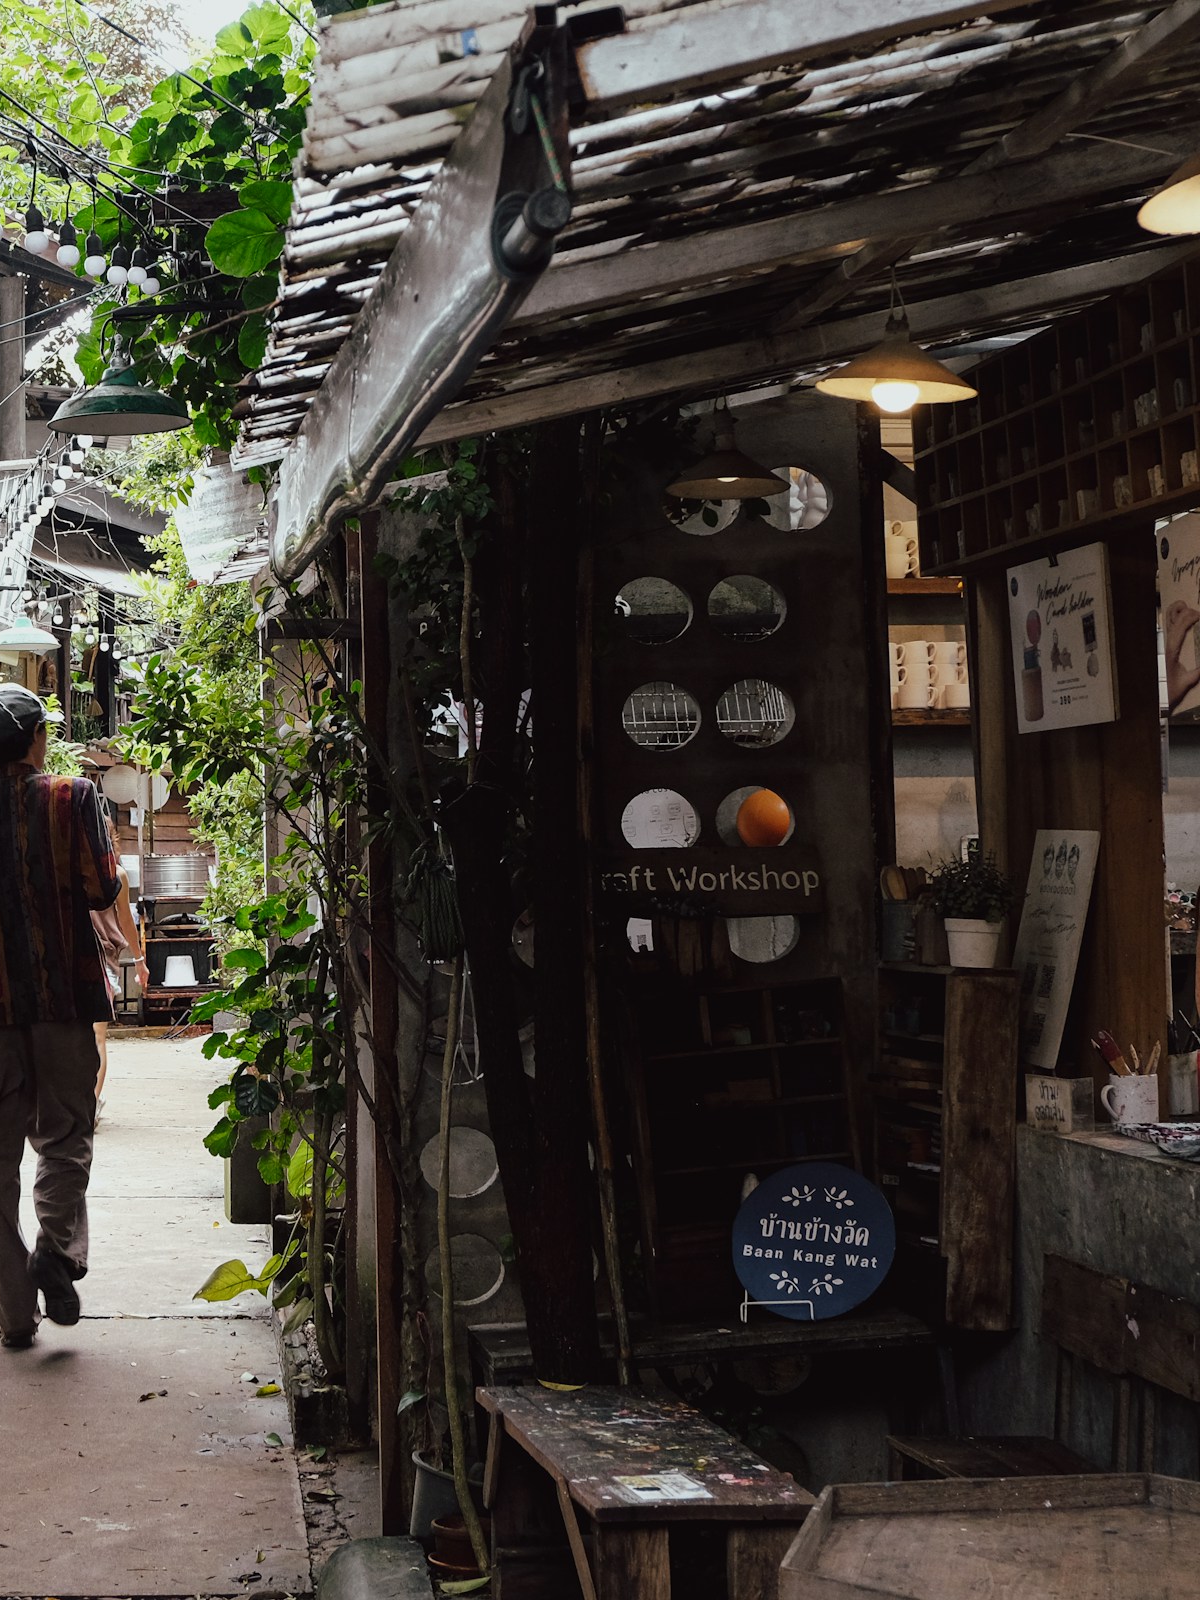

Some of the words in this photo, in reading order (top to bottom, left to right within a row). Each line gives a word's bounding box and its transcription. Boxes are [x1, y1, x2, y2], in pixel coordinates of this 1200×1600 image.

[1036, 576, 1072, 609] Wooden
[666, 863, 820, 897] Workshop
[759, 1213, 870, 1247] บ้านข้างวัด
[742, 1244, 784, 1260] Baan
[792, 1249, 836, 1267] Kang
[844, 1254, 878, 1269] Wat
